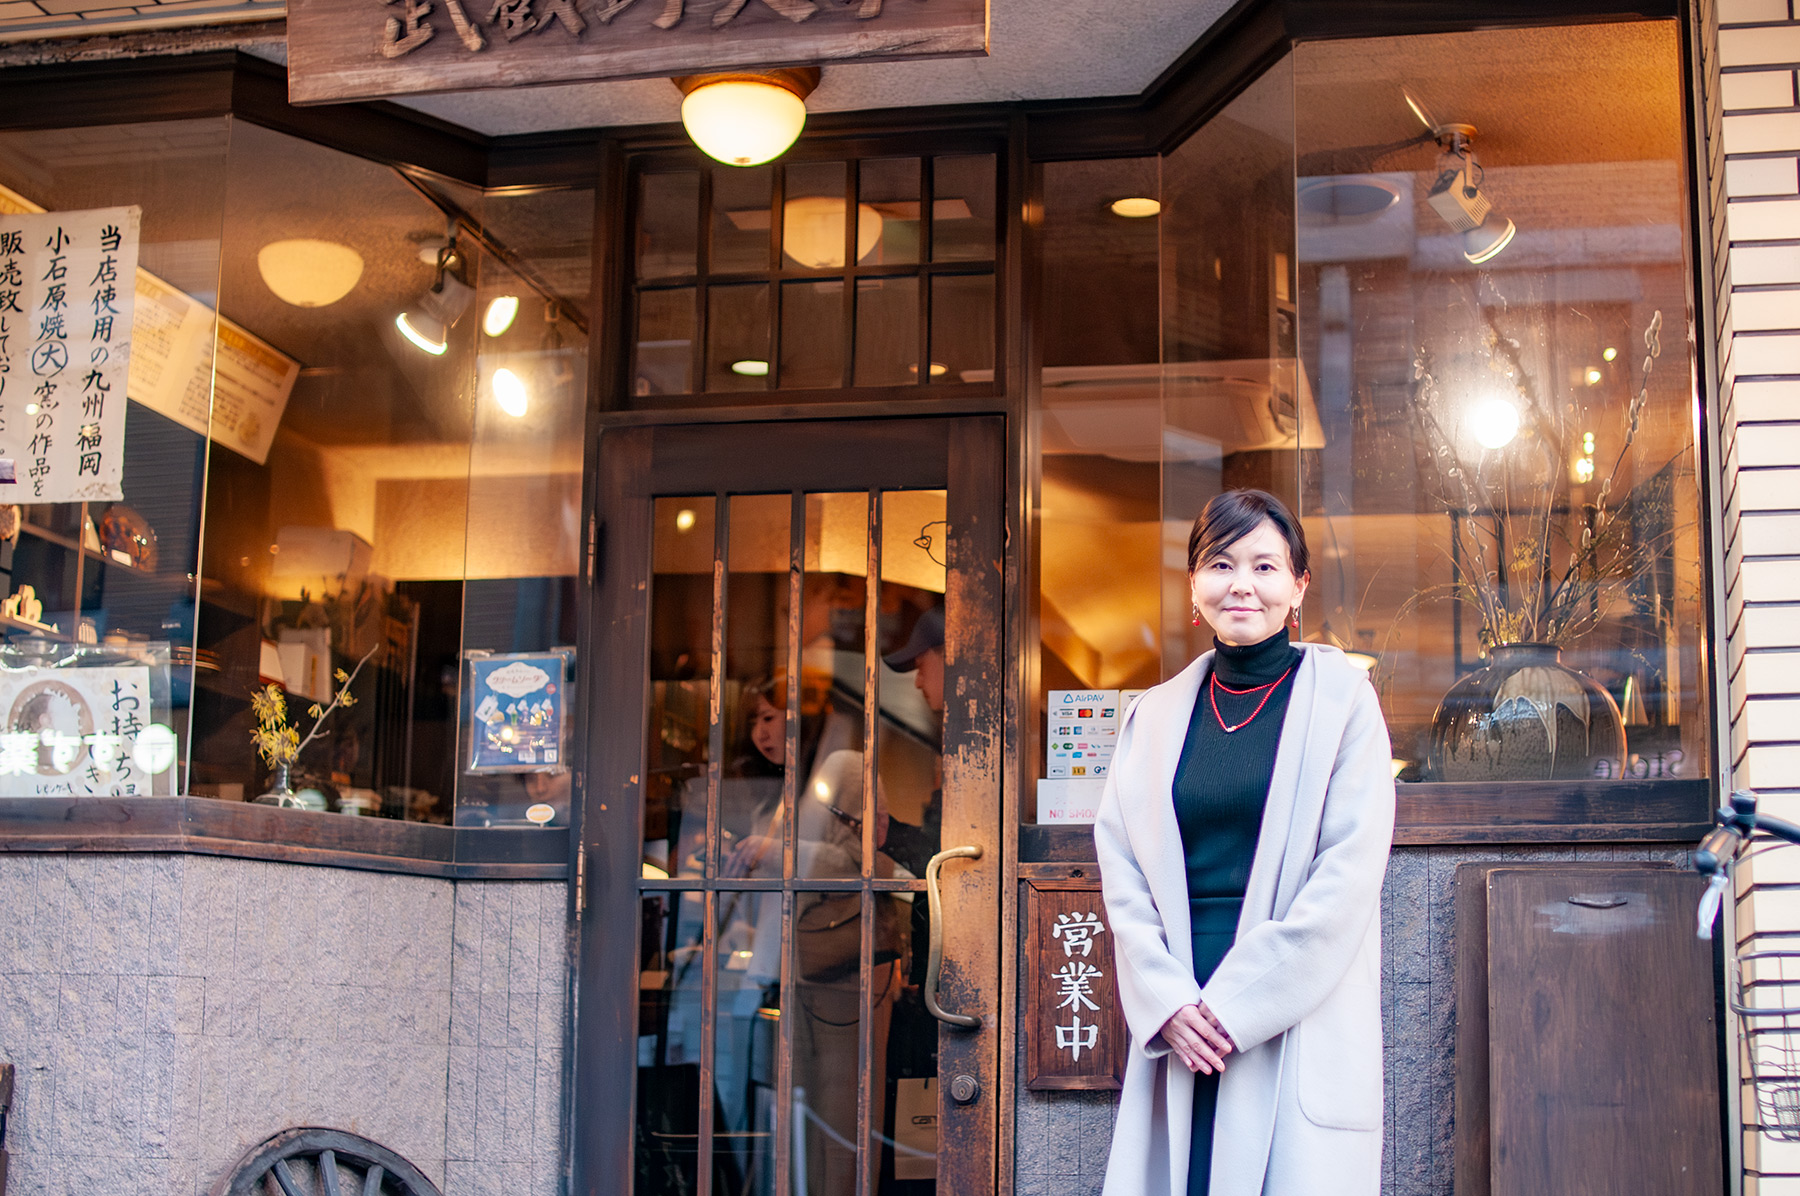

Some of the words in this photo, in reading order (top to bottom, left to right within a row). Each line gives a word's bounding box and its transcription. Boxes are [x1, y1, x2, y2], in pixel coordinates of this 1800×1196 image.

[75, 224, 122, 476] 当店使用の九州福岡
[1049, 809, 1064, 818] NO
[1052, 911, 1105, 1063] 営業中
